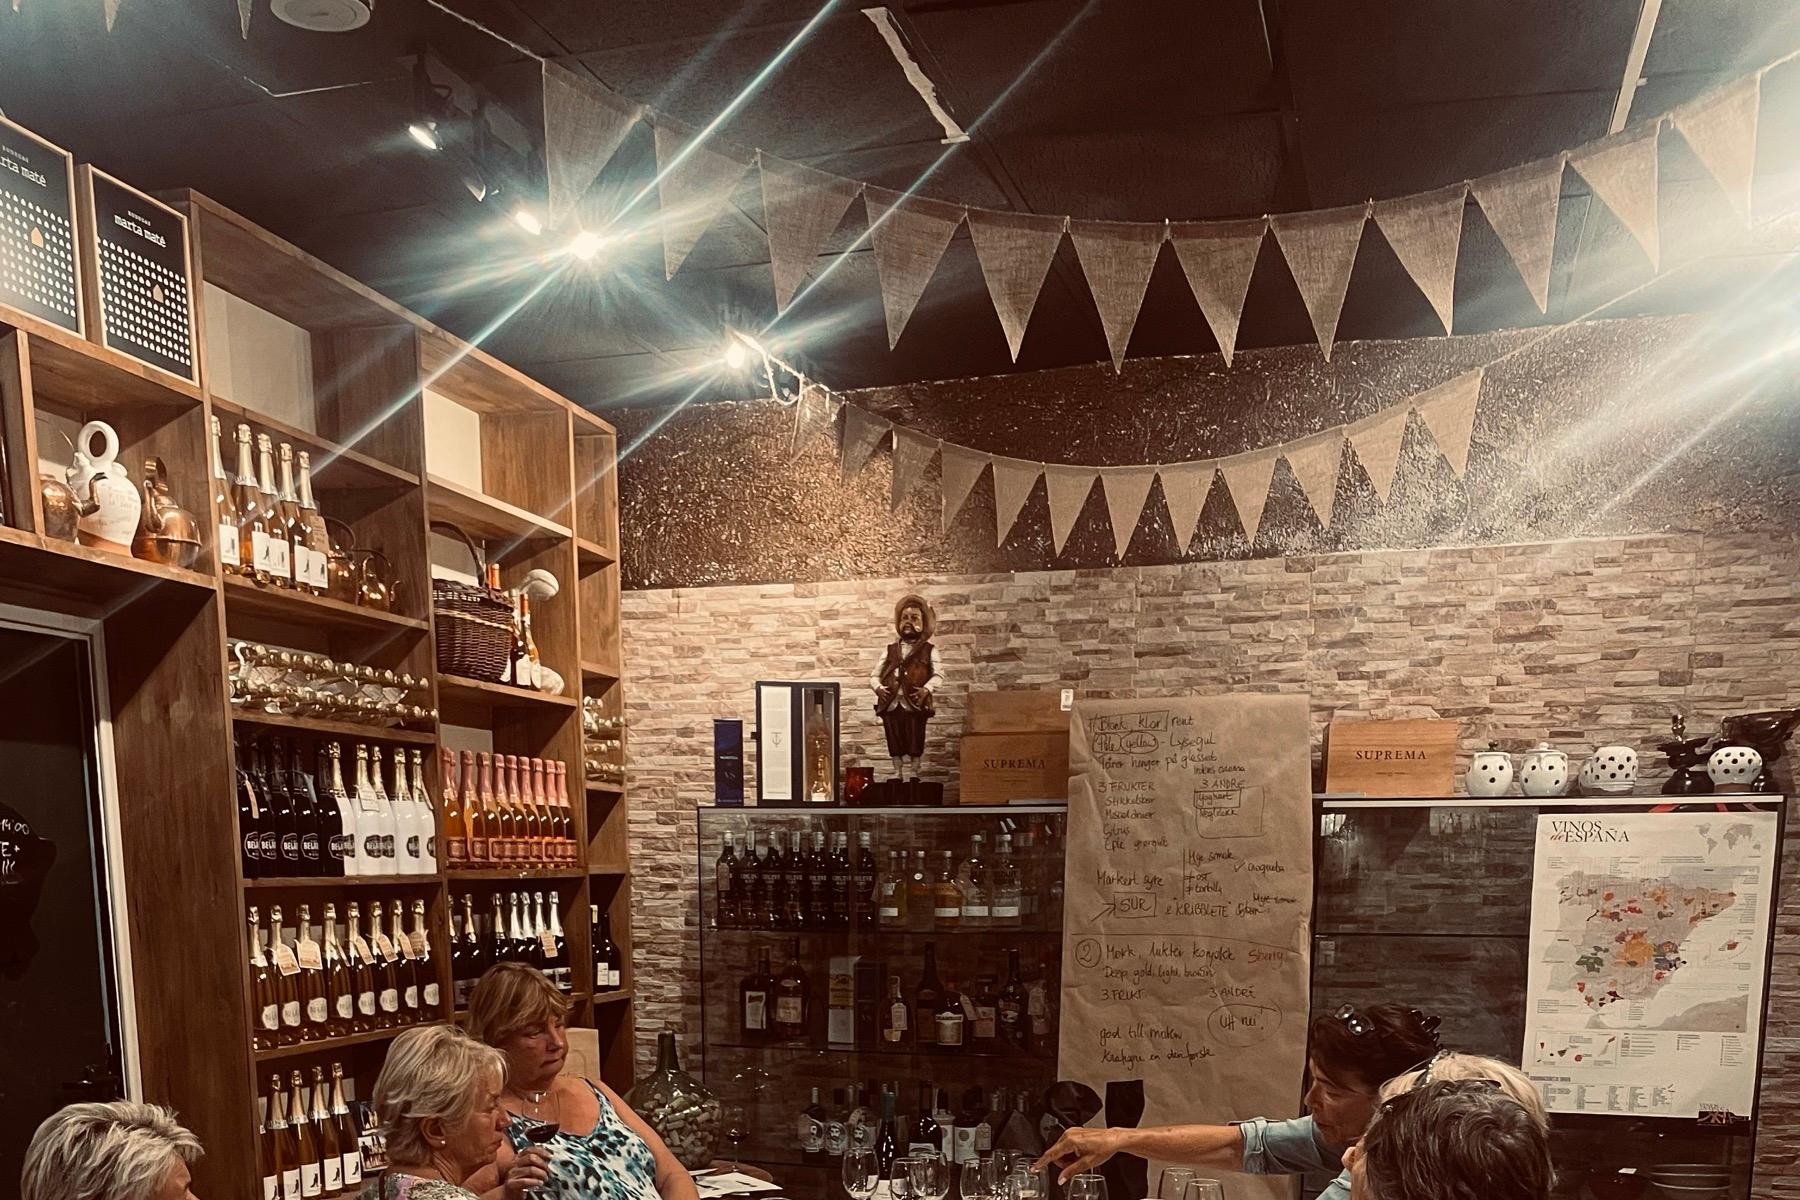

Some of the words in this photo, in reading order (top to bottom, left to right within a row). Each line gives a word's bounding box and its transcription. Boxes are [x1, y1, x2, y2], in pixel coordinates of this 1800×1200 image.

[0, 156, 20, 174] rta
[21, 165, 47, 187] maté
[114, 214, 144, 237] marta
[143, 229, 167, 248] maté
[1355, 750, 1427, 760] SUPREMA
[983, 759, 1047, 769] SUPREMA
[1098, 781, 1107, 793] 3
[1109, 781, 1156, 792] FRUKTER
[1200, 778, 1209, 789] 3
[1552, 820, 1602, 832] VINOS
[1565, 828, 1629, 843] ESPAÑA
[1119, 897, 1152, 913] SUR
[1101, 989, 1110, 1001] 3
[1208, 987, 1218, 999] 3
